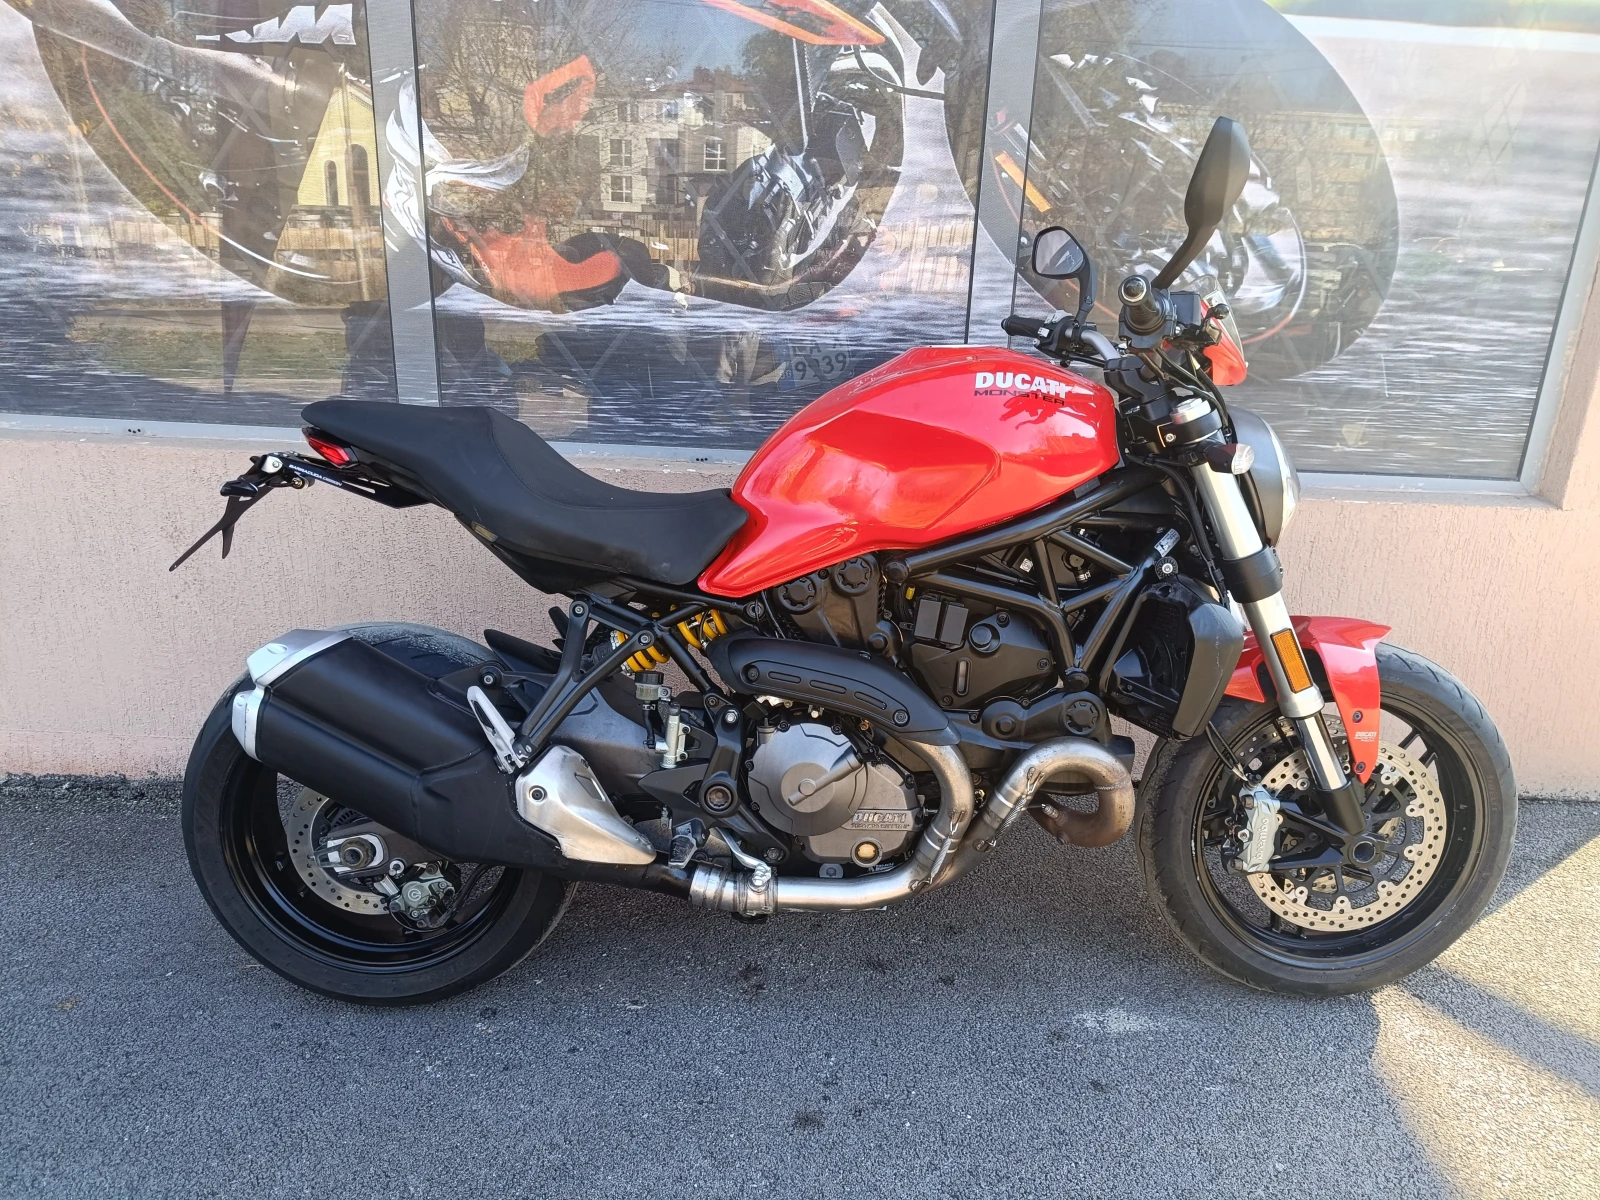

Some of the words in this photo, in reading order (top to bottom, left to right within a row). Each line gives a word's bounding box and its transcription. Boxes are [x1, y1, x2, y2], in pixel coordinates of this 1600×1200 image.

[975, 371, 1066, 399] DUCATI
[974, 389, 1065, 406] MONSTER
[852, 812, 907, 823] DUCATI
[1253, 817, 1269, 860] brembo
